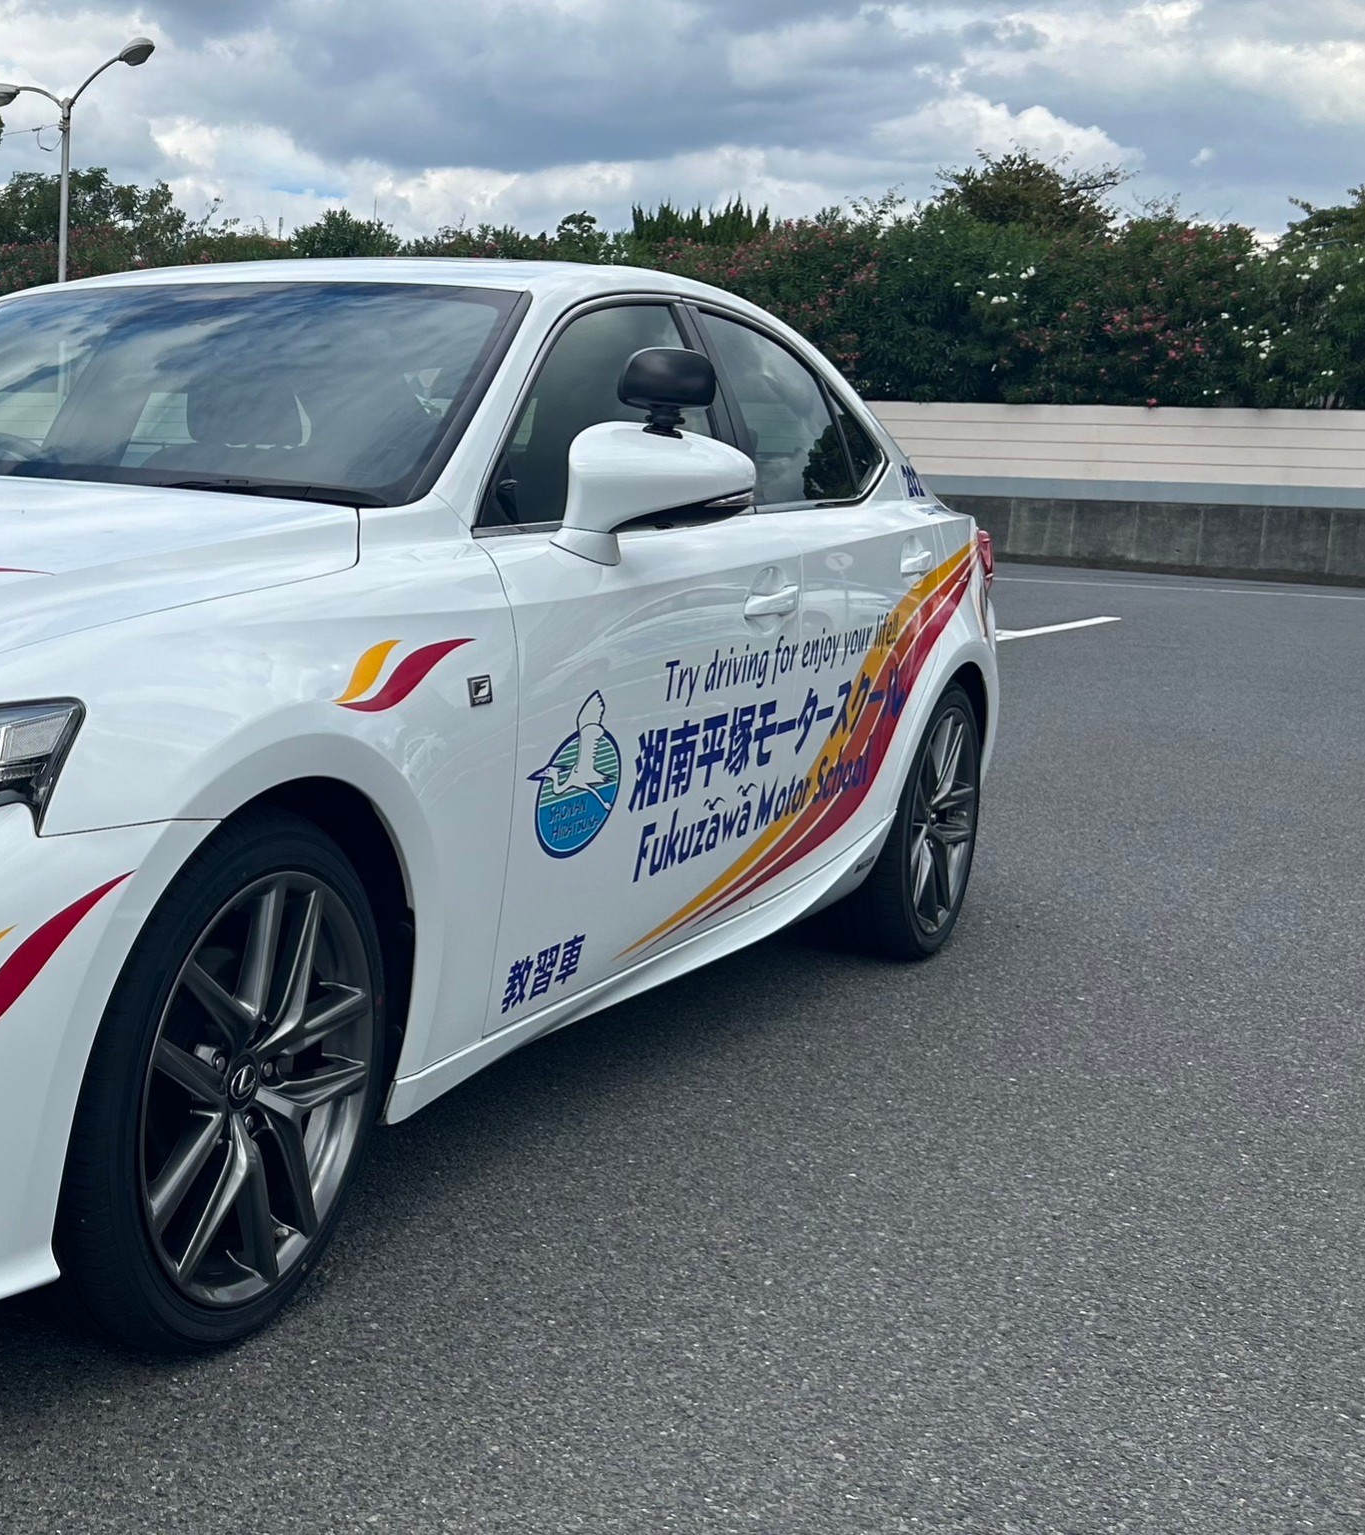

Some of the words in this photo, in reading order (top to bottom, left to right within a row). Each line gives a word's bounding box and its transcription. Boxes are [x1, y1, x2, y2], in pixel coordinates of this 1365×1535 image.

[665, 660, 700, 707] Try
[704, 644, 770, 689] driving
[771, 635, 798, 685] for
[801, 628, 841, 674] enjoy
[841, 621, 873, 666] your
[628, 668, 906, 813] 湘南平塚モータースクール
[753, 773, 812, 831] Motor
[812, 734, 873, 805] School
[501, 934, 586, 1014] 教習車
